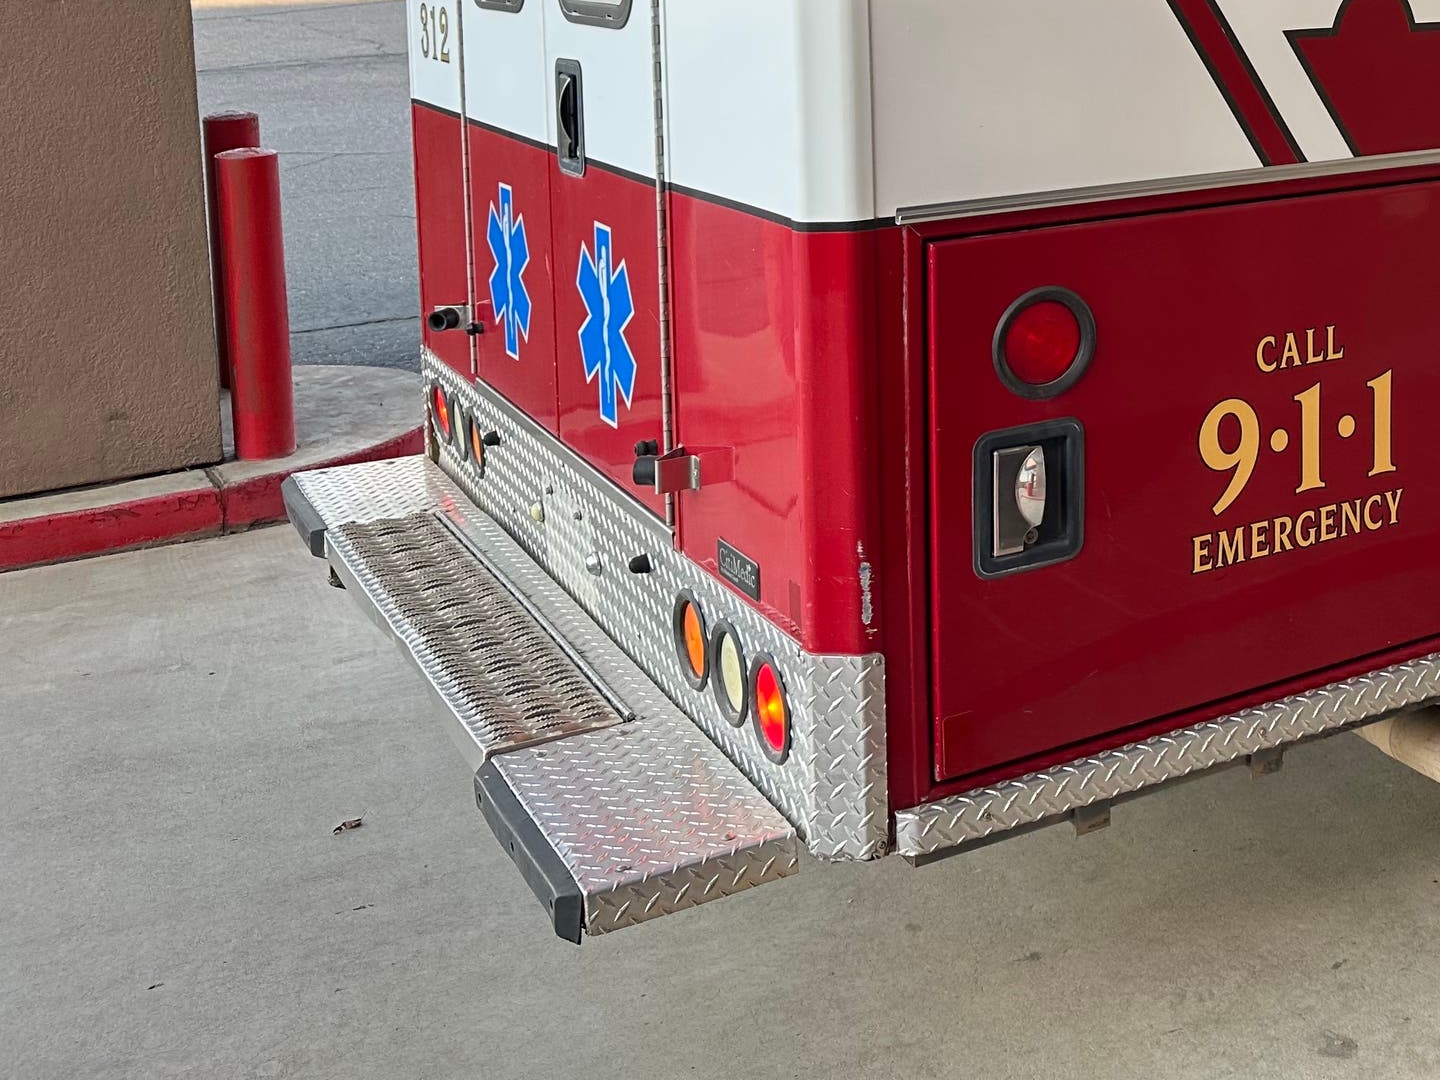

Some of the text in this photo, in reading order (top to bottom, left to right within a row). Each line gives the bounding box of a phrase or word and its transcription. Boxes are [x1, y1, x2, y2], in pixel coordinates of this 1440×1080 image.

[420, 2, 450, 64] 312
[1255, 324, 1344, 373] CALL
[1192, 488, 1404, 575] EMERGENCY
